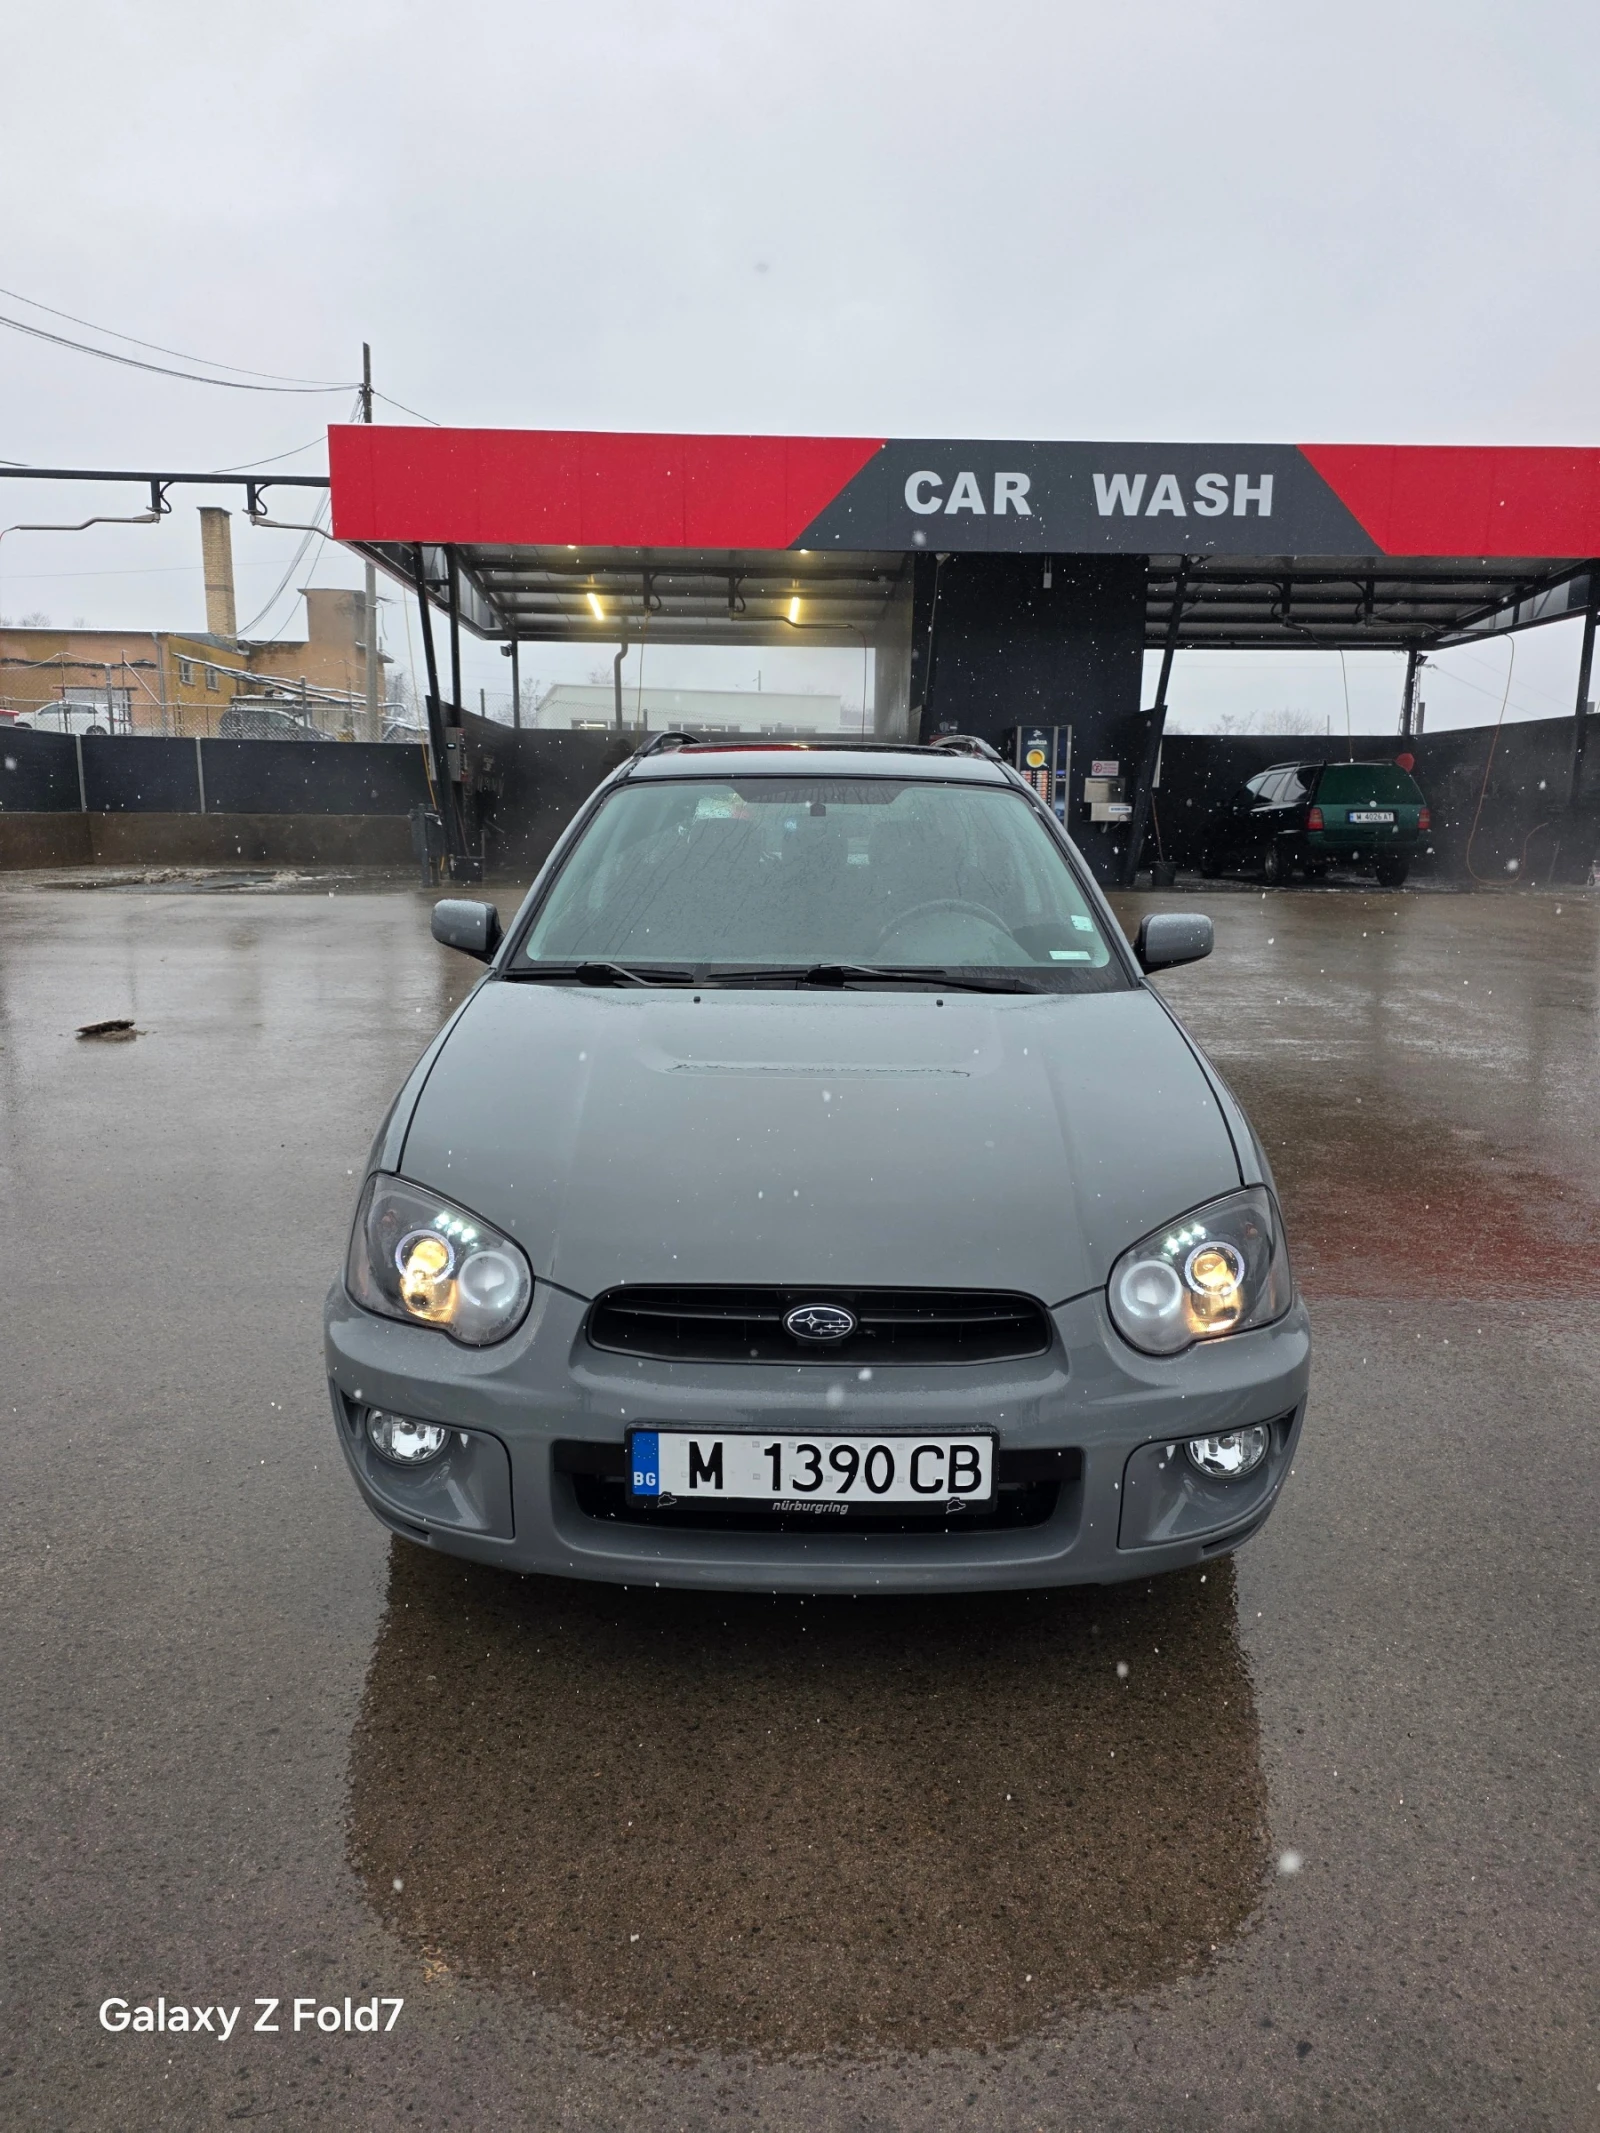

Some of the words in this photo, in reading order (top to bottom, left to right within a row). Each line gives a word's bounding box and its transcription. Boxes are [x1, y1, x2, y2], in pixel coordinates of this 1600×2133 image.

[904, 470, 1032, 515] CAR
[1092, 473, 1274, 517] WASH
[633, 1471, 657, 1487] BG
[688, 1441, 723, 1490] M
[764, 1443, 895, 1494] 1390
[910, 1445, 982, 1494] CB
[772, 1500, 849, 1515] nürburgring
